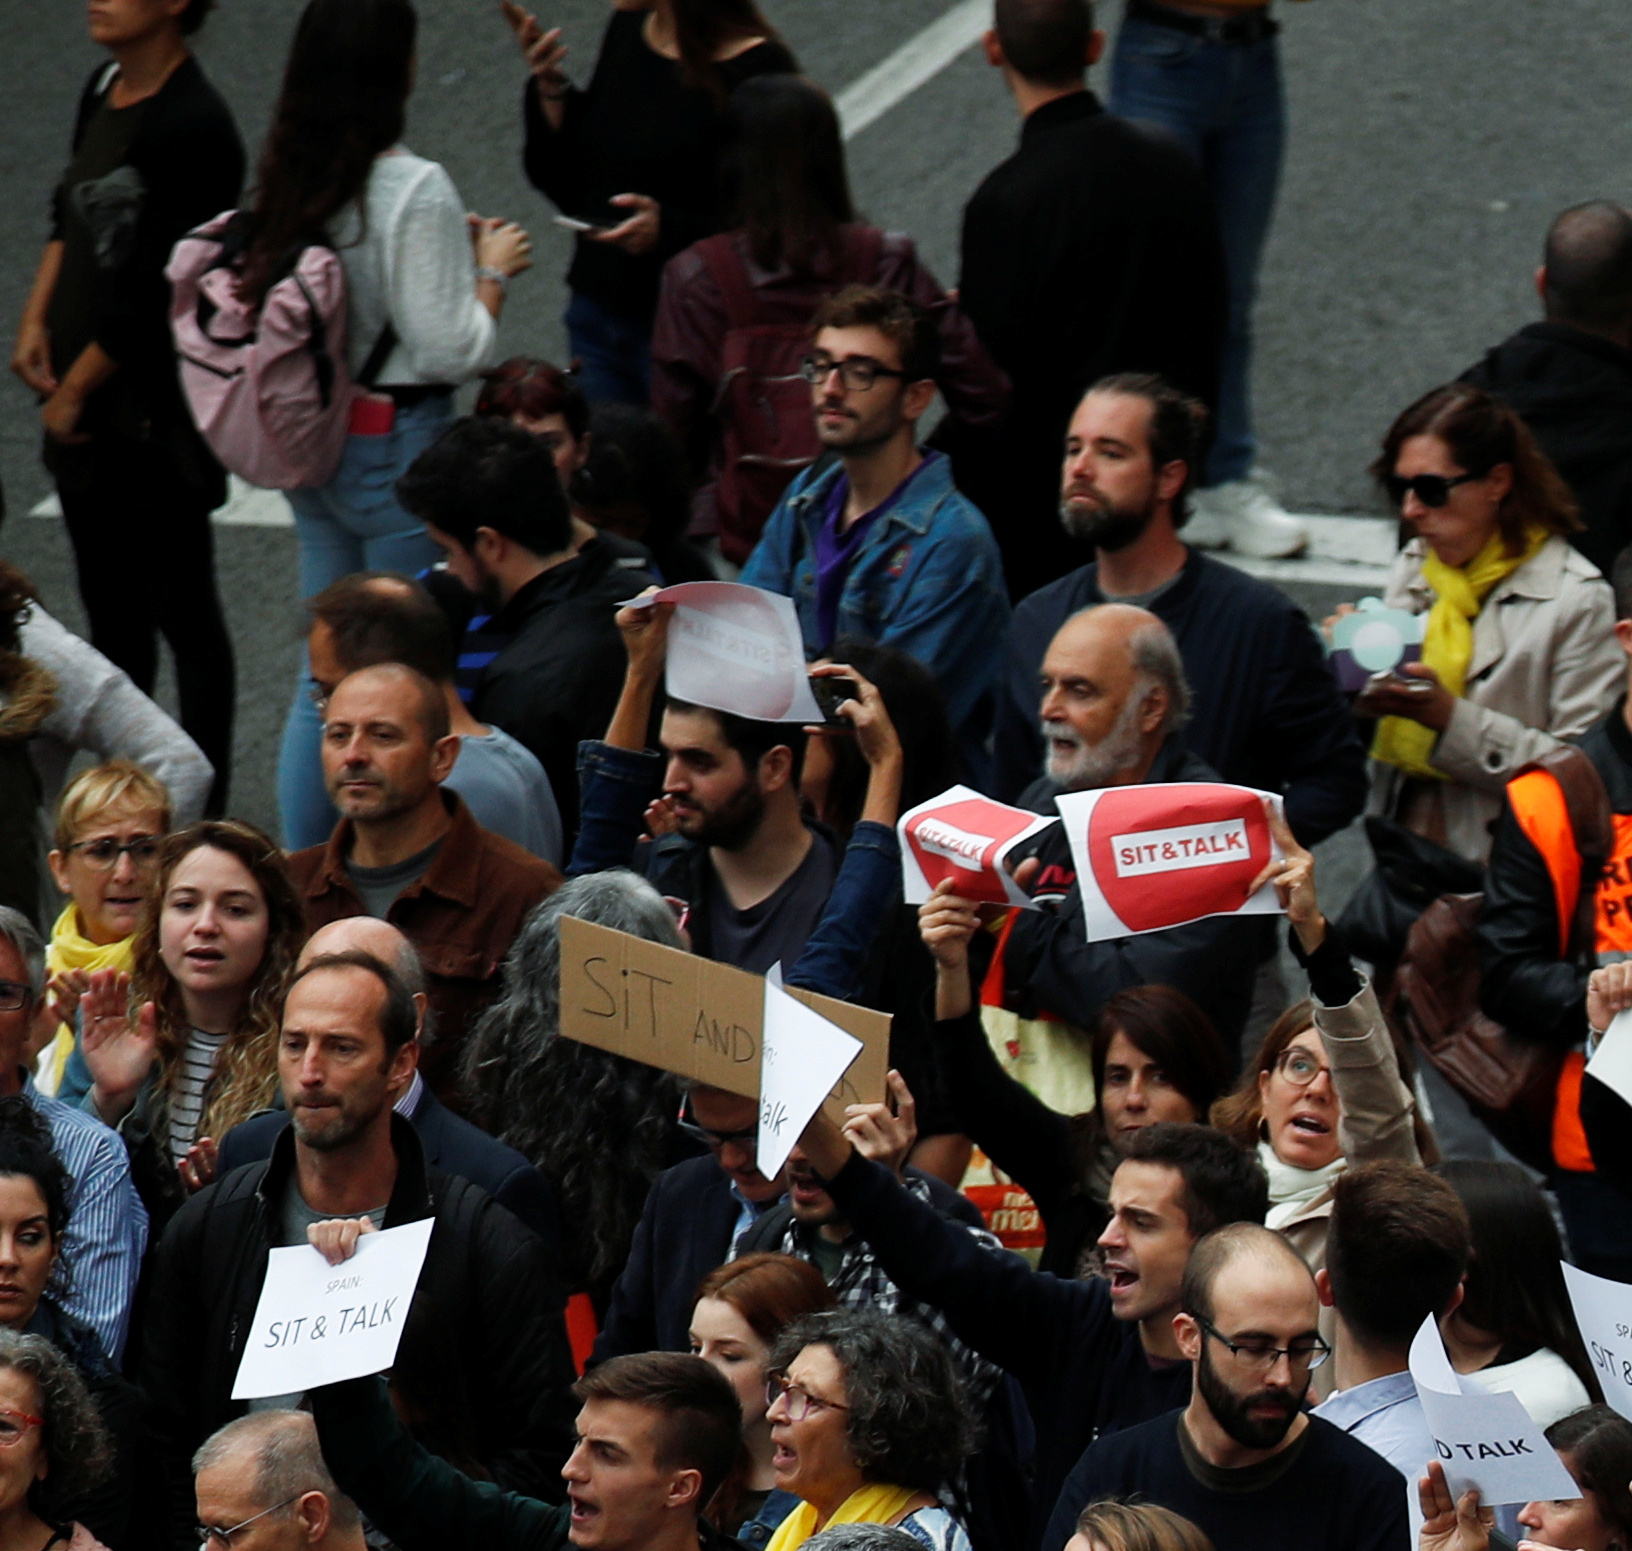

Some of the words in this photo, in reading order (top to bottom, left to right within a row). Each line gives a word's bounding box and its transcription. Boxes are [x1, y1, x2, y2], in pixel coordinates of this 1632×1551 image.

[1120, 831, 1246, 866] SIT&TALK
[693, 1010, 757, 1065] AND
[326, 1274, 363, 1296] SPAIN:
[264, 1317, 308, 1350] SIT
[311, 1314, 327, 1341] &
[338, 1296, 399, 1336] TALK
[1591, 1340, 1617, 1377] SIT
[1454, 1437, 1535, 1462] TALK
